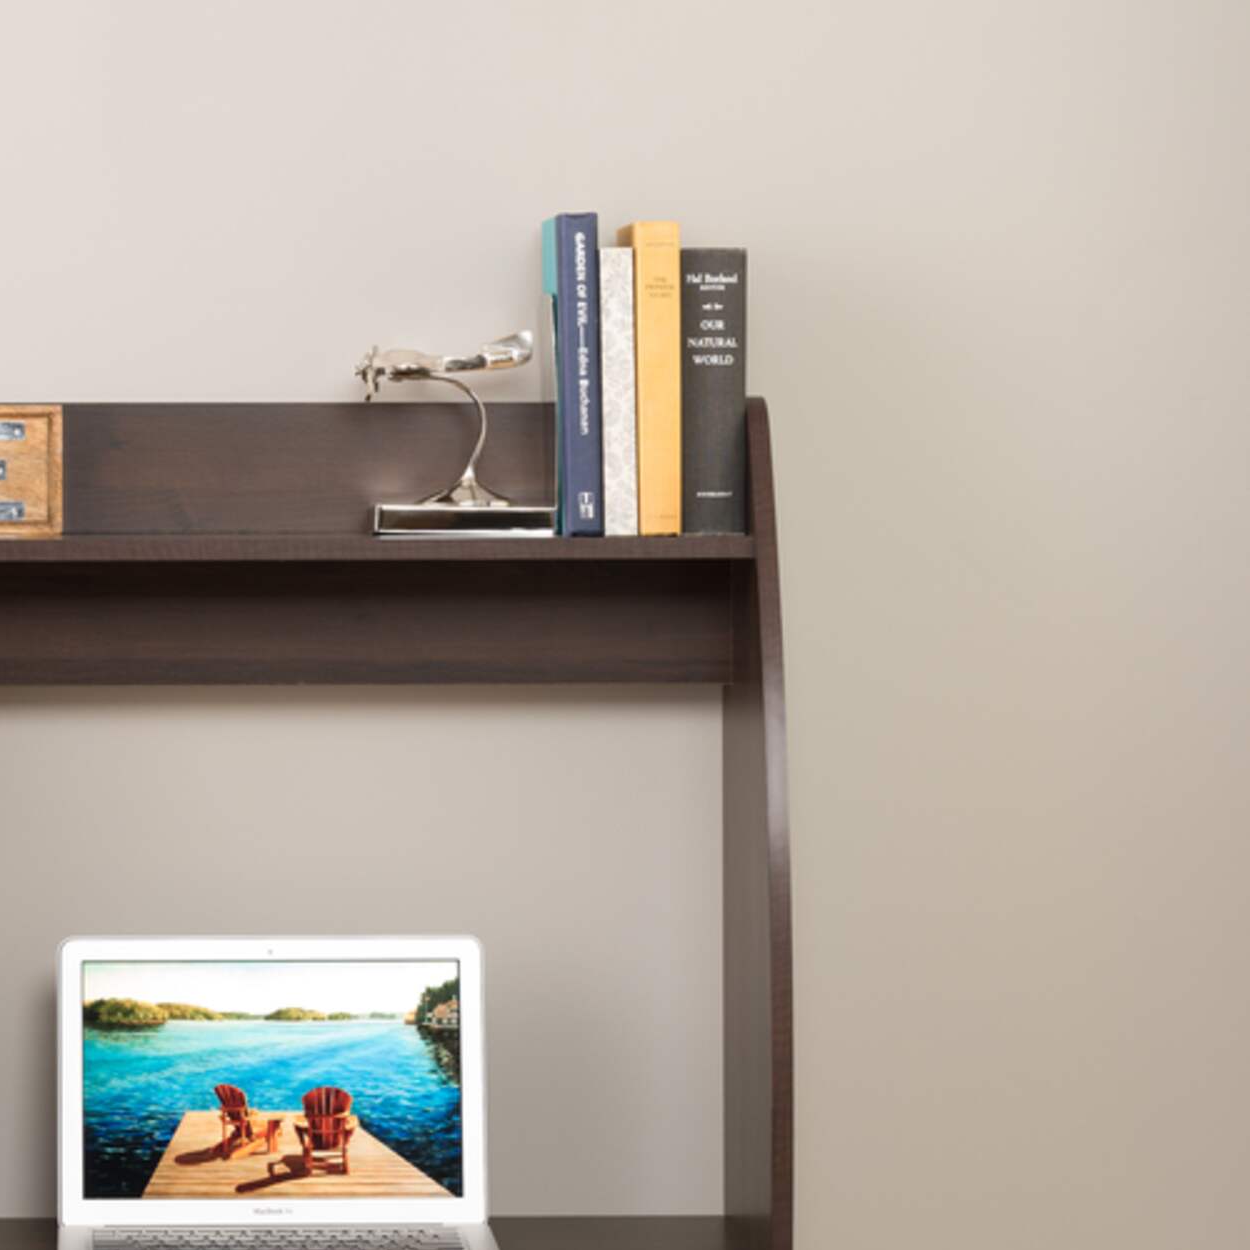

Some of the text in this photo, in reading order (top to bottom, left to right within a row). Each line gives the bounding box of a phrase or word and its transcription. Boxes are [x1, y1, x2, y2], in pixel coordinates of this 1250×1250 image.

[575, 232, 586, 281] GARDEN
[577, 284, 587, 298] OF
[699, 319, 725, 331] OUR
[686, 336, 738, 348] NATURAL
[692, 354, 735, 366] WORLD
[579, 379, 590, 435] Buchanan
